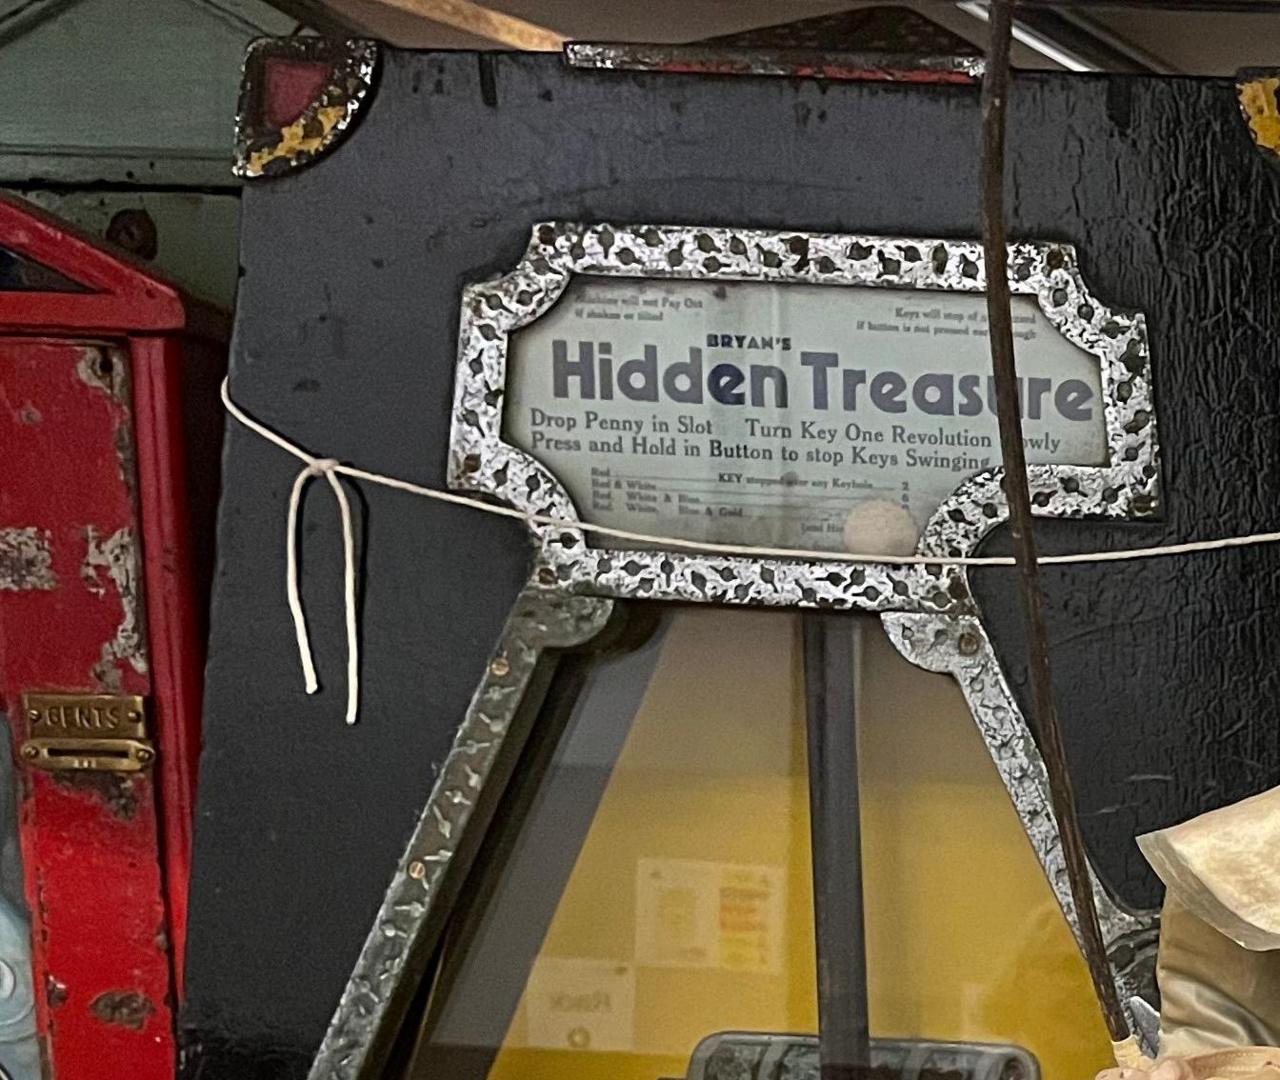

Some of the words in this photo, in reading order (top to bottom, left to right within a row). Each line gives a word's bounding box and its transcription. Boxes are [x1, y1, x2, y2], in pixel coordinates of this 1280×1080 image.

[706, 333, 792, 351] BRYAN'S
[552, 339, 789, 409] Hidden
[530, 407, 577, 431] Drop
[585, 410, 644, 435] Penny
[651, 413, 670, 433] in
[677, 414, 713, 435] Slot
[744, 417, 792, 440] Turn
[801, 420, 838, 442] Key
[845, 422, 884, 443] One
[892, 424, 992, 449] Revolution
[531, 431, 582, 452] Press
[588, 437, 616, 453] and
[631, 436, 676, 457] Hold
[684, 438, 700, 457] in
[708, 439, 773, 461] Button
[781, 443, 799, 462] to
[806, 446, 844, 467] stop
[851, 446, 899, 468] Keys
[905, 448, 991, 473] Swinging
[718, 472, 744, 485] KEY
